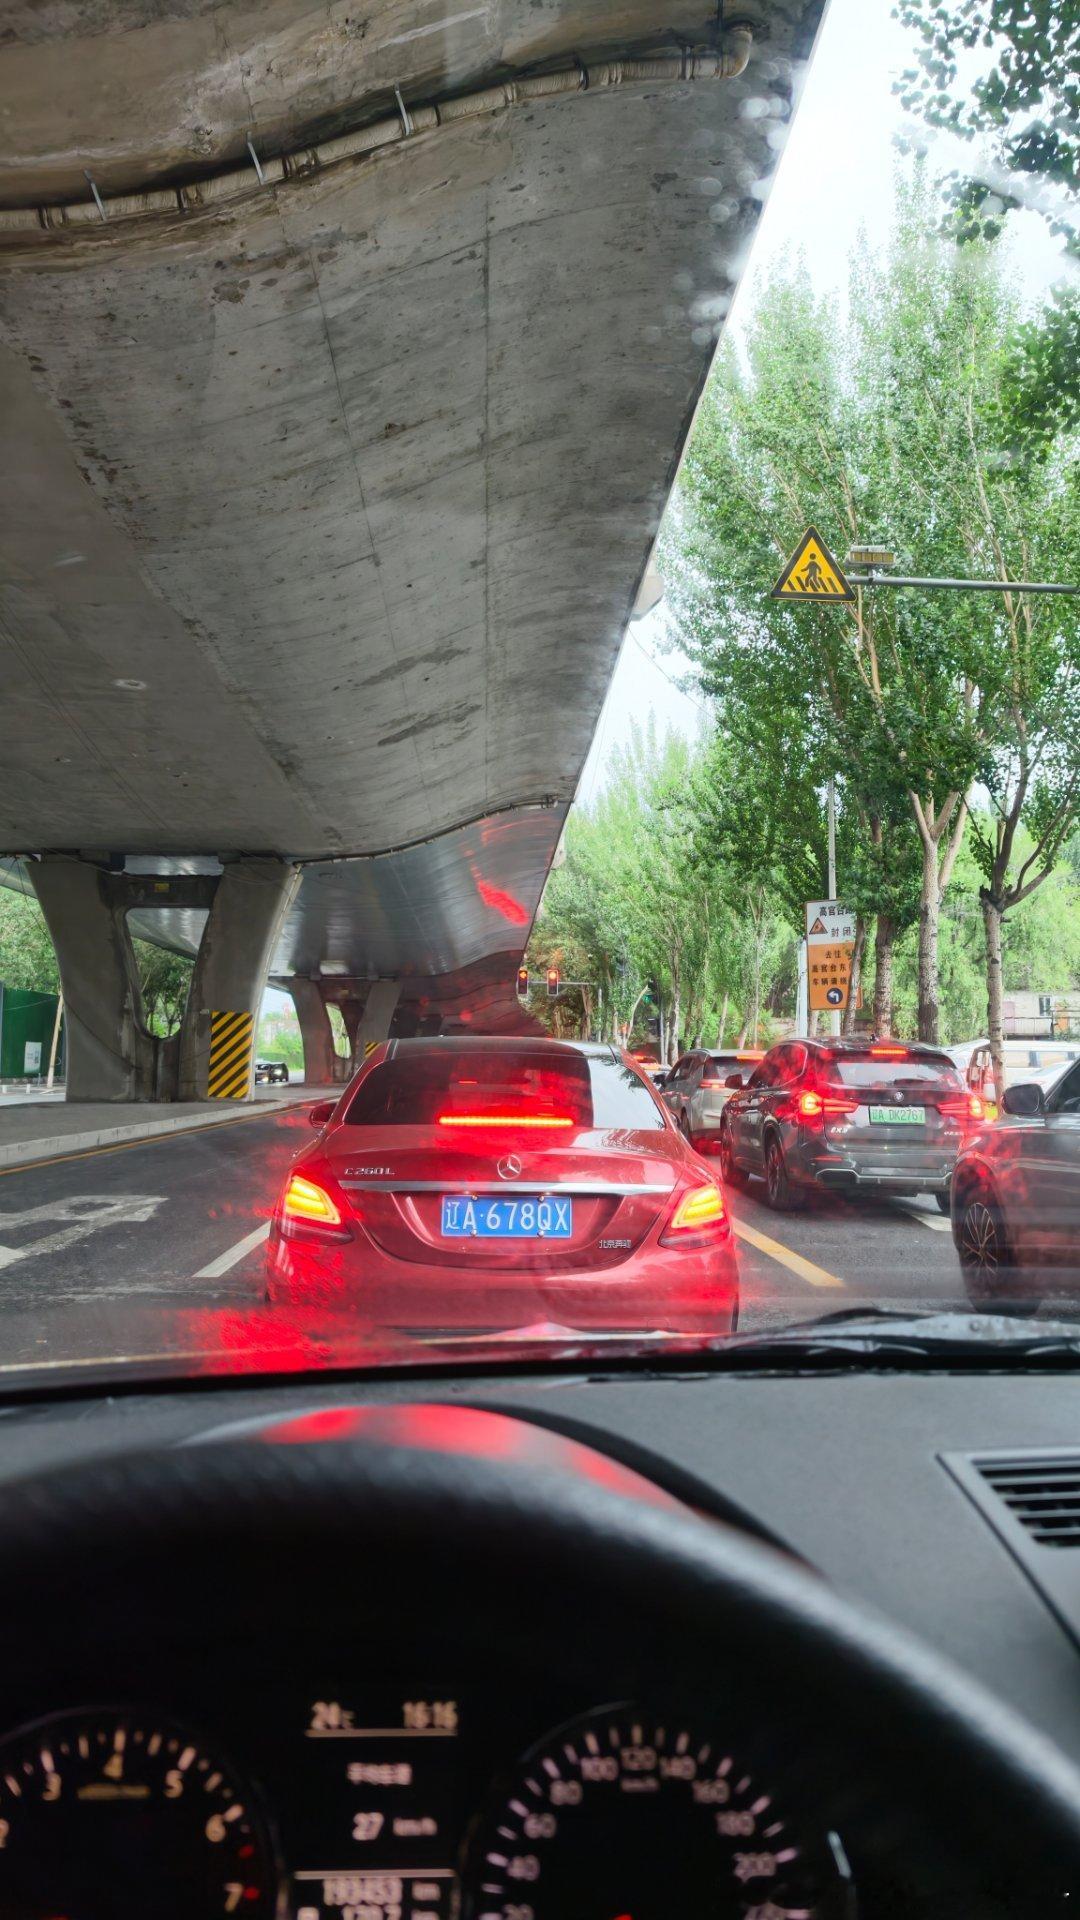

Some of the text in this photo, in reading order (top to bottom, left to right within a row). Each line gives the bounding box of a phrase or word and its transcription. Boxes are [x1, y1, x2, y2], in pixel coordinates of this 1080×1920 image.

[831, 926, 857, 938] 封闭
[811, 963, 850, 973] 高官台东
[164, 1769, 184, 1799] 5
[205, 1814, 227, 1843] 6
[223, 1882, 244, 1913] 7
